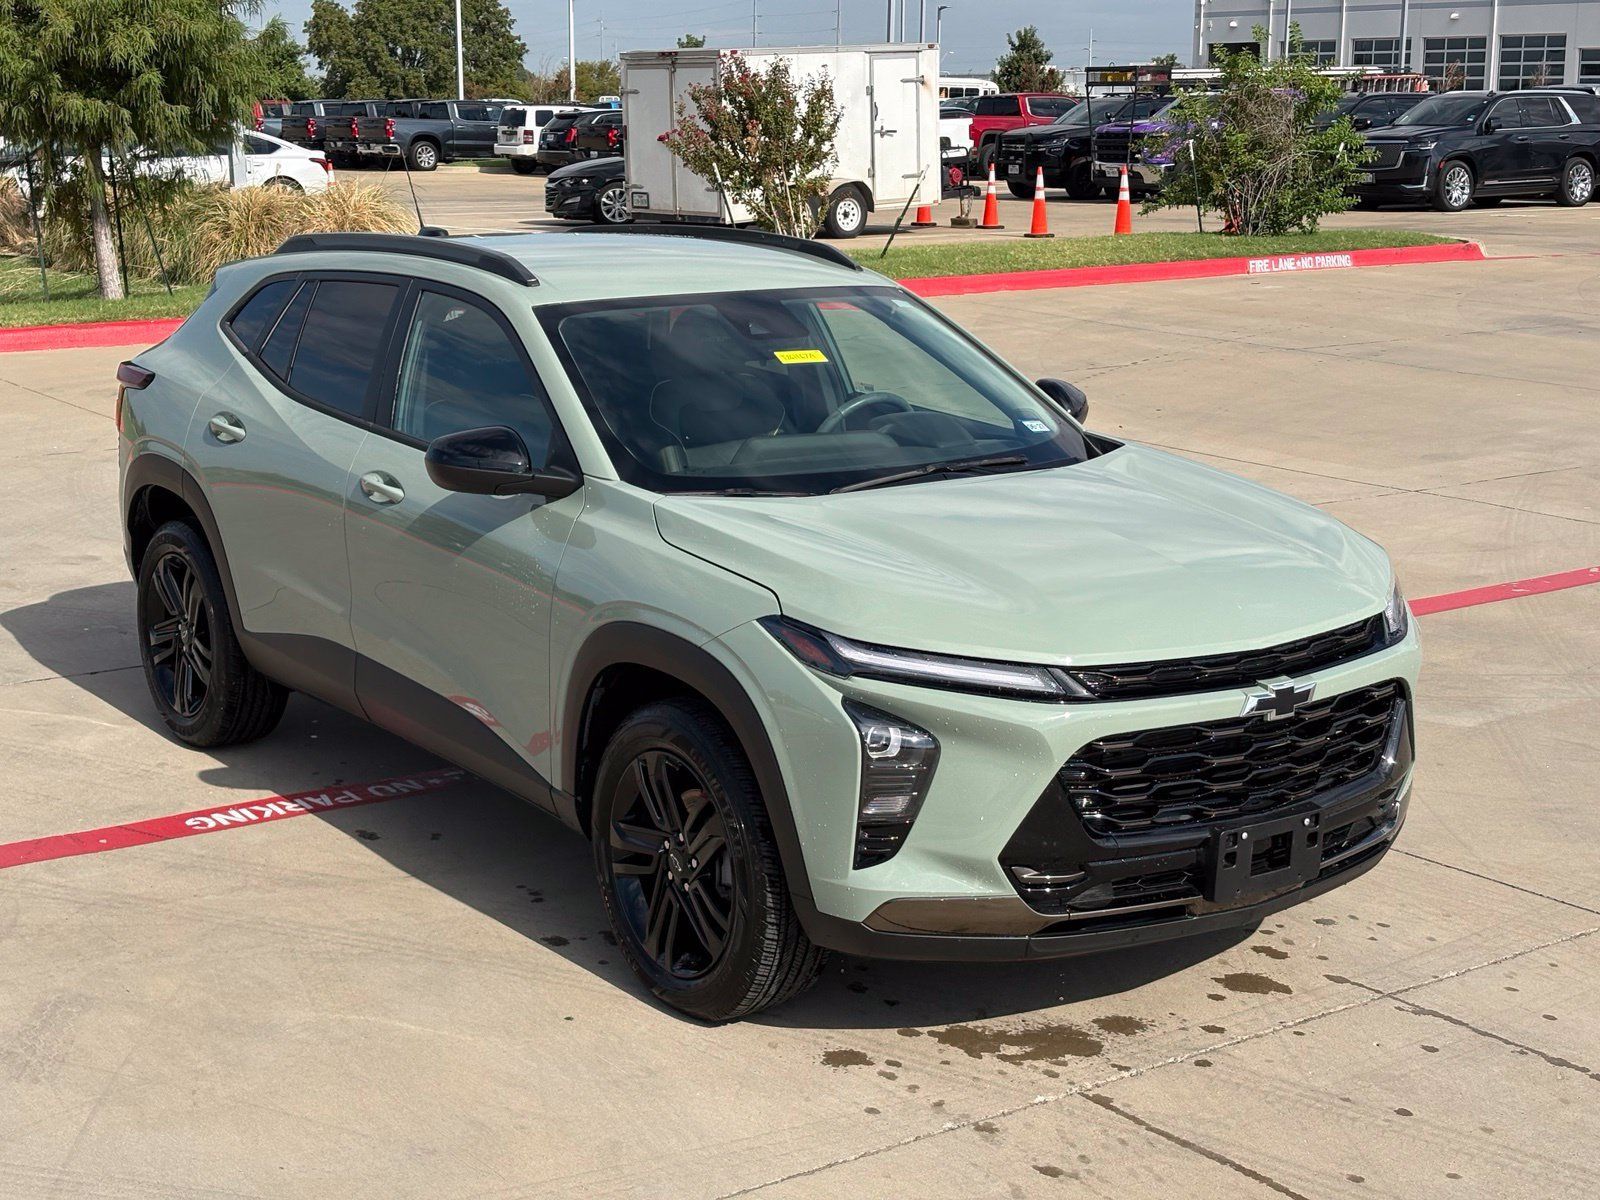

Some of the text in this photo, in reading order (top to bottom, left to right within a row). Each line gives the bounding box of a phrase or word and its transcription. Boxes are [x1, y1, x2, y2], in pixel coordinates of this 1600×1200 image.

[1249, 254, 1352, 273] FIRE LANE NO PARKING
[184, 778, 421, 830] NO PARKING
